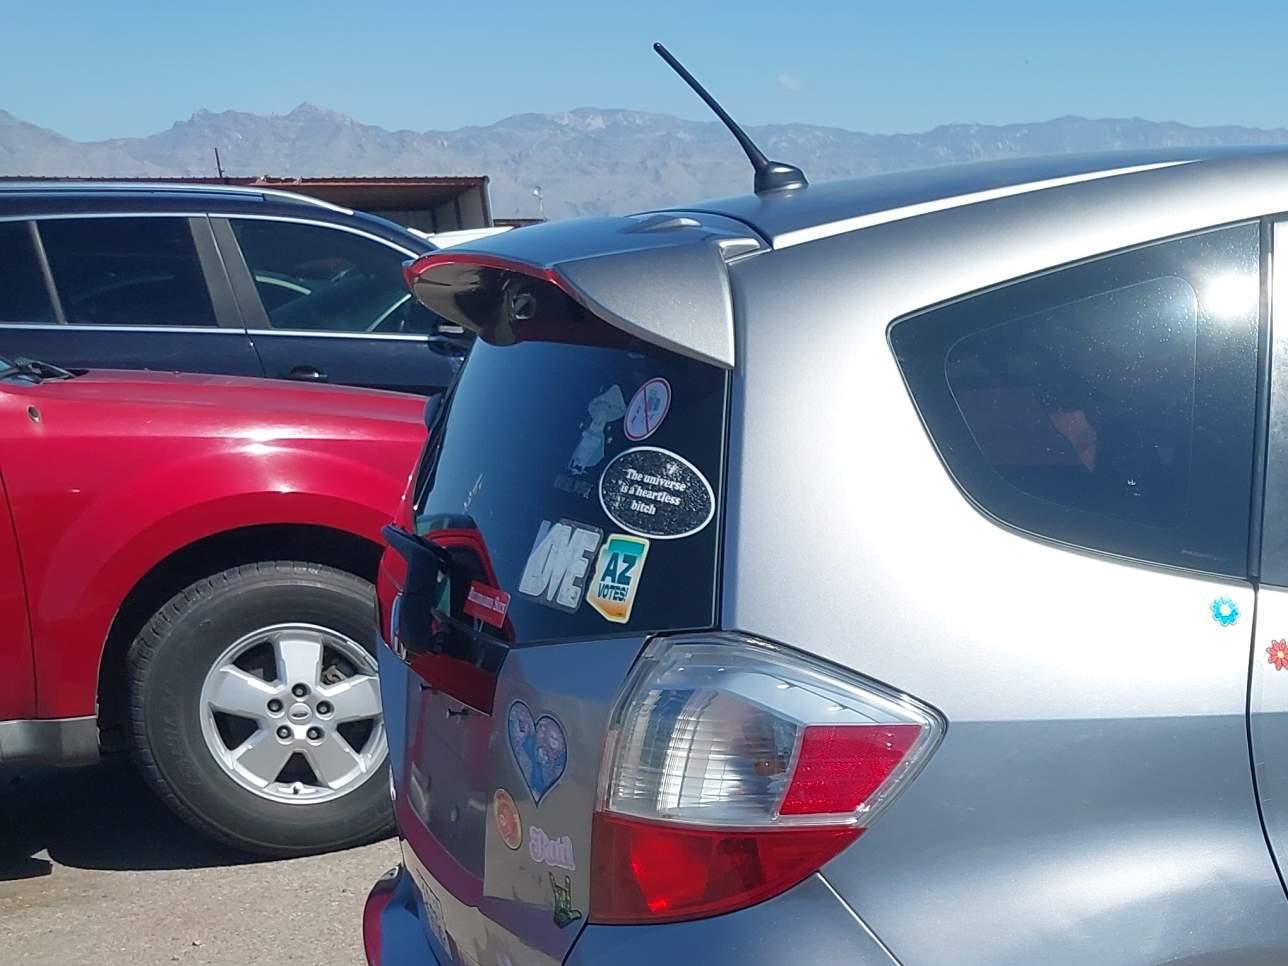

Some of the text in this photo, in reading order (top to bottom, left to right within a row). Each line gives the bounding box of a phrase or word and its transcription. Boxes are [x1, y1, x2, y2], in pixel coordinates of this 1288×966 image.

[624, 468, 686, 492] The universe
[636, 485, 681, 506] heartless
[630, 499, 657, 515] bitch
[601, 551, 638, 585] AZ
[597, 582, 629, 602] VOTES!
